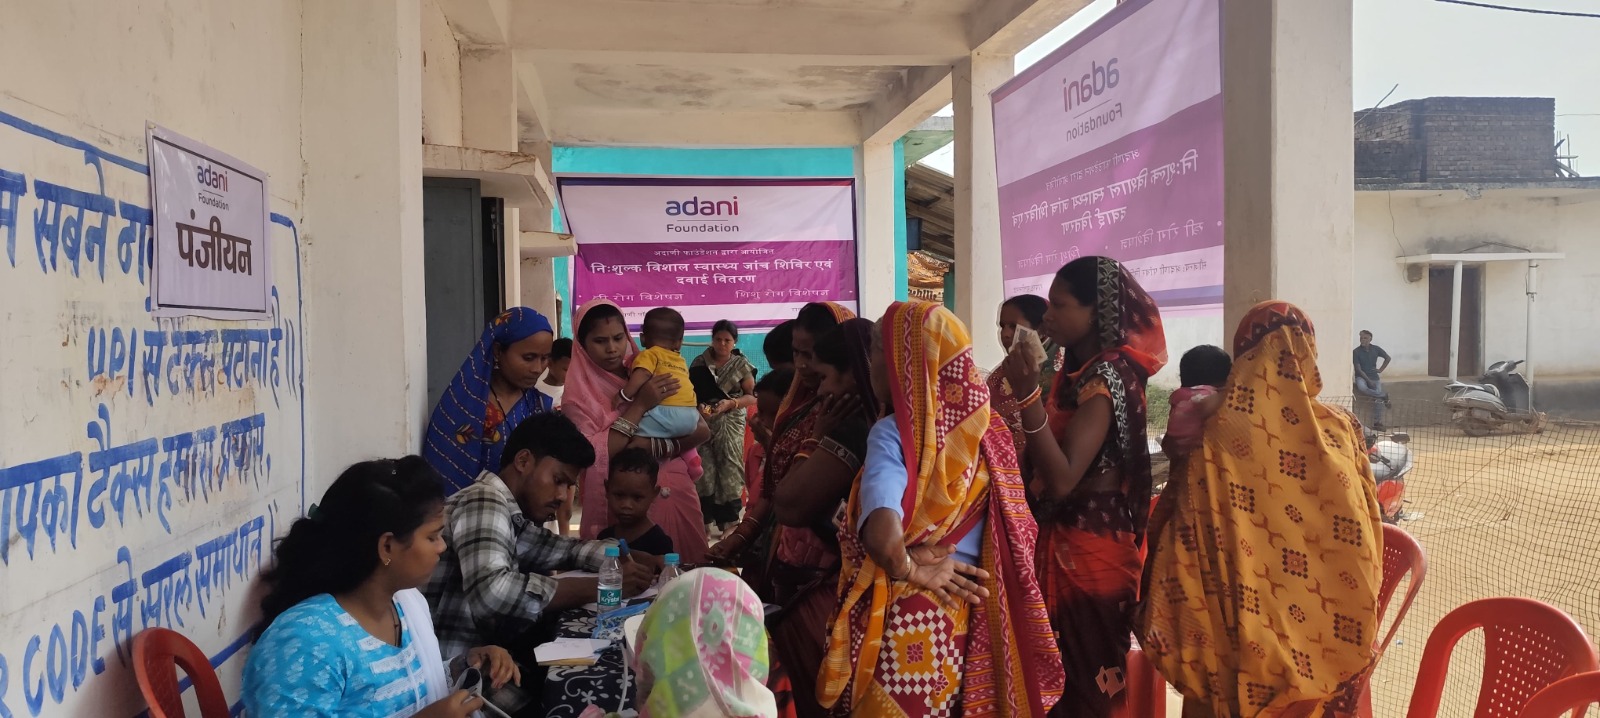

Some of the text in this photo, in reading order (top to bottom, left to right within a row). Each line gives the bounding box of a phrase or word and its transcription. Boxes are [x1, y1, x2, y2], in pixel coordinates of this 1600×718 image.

[197, 164, 228, 193] adani
[198, 192, 230, 211] Foundation
[665, 196, 739, 217] adani
[34, 149, 117, 284] सबने
[118, 200, 153, 286] ठा
[666, 223, 739, 233] Foundation
[175, 208, 252, 276] पंजीयन
[654, 249, 680, 257] अदाणी
[646, 261, 690, 273] विशाल
[693, 261, 739, 272] स्वास्थ्य
[743, 259, 770, 271] जांच
[773, 258, 812, 271] शिविर
[813, 258, 834, 271] एवं
[676, 272, 757, 286] दवाई वितरण
[613, 292, 635, 302] रोग
[735, 289, 760, 300] शिशु
[765, 288, 785, 298] रोग
[88, 326, 137, 398] UPI
[0, 451, 83, 567] पका
[87, 402, 159, 529] टैक्स
[23, 595, 106, 718] CODE
[111, 546, 138, 668] से
[195, 515, 265, 620] समाधान
